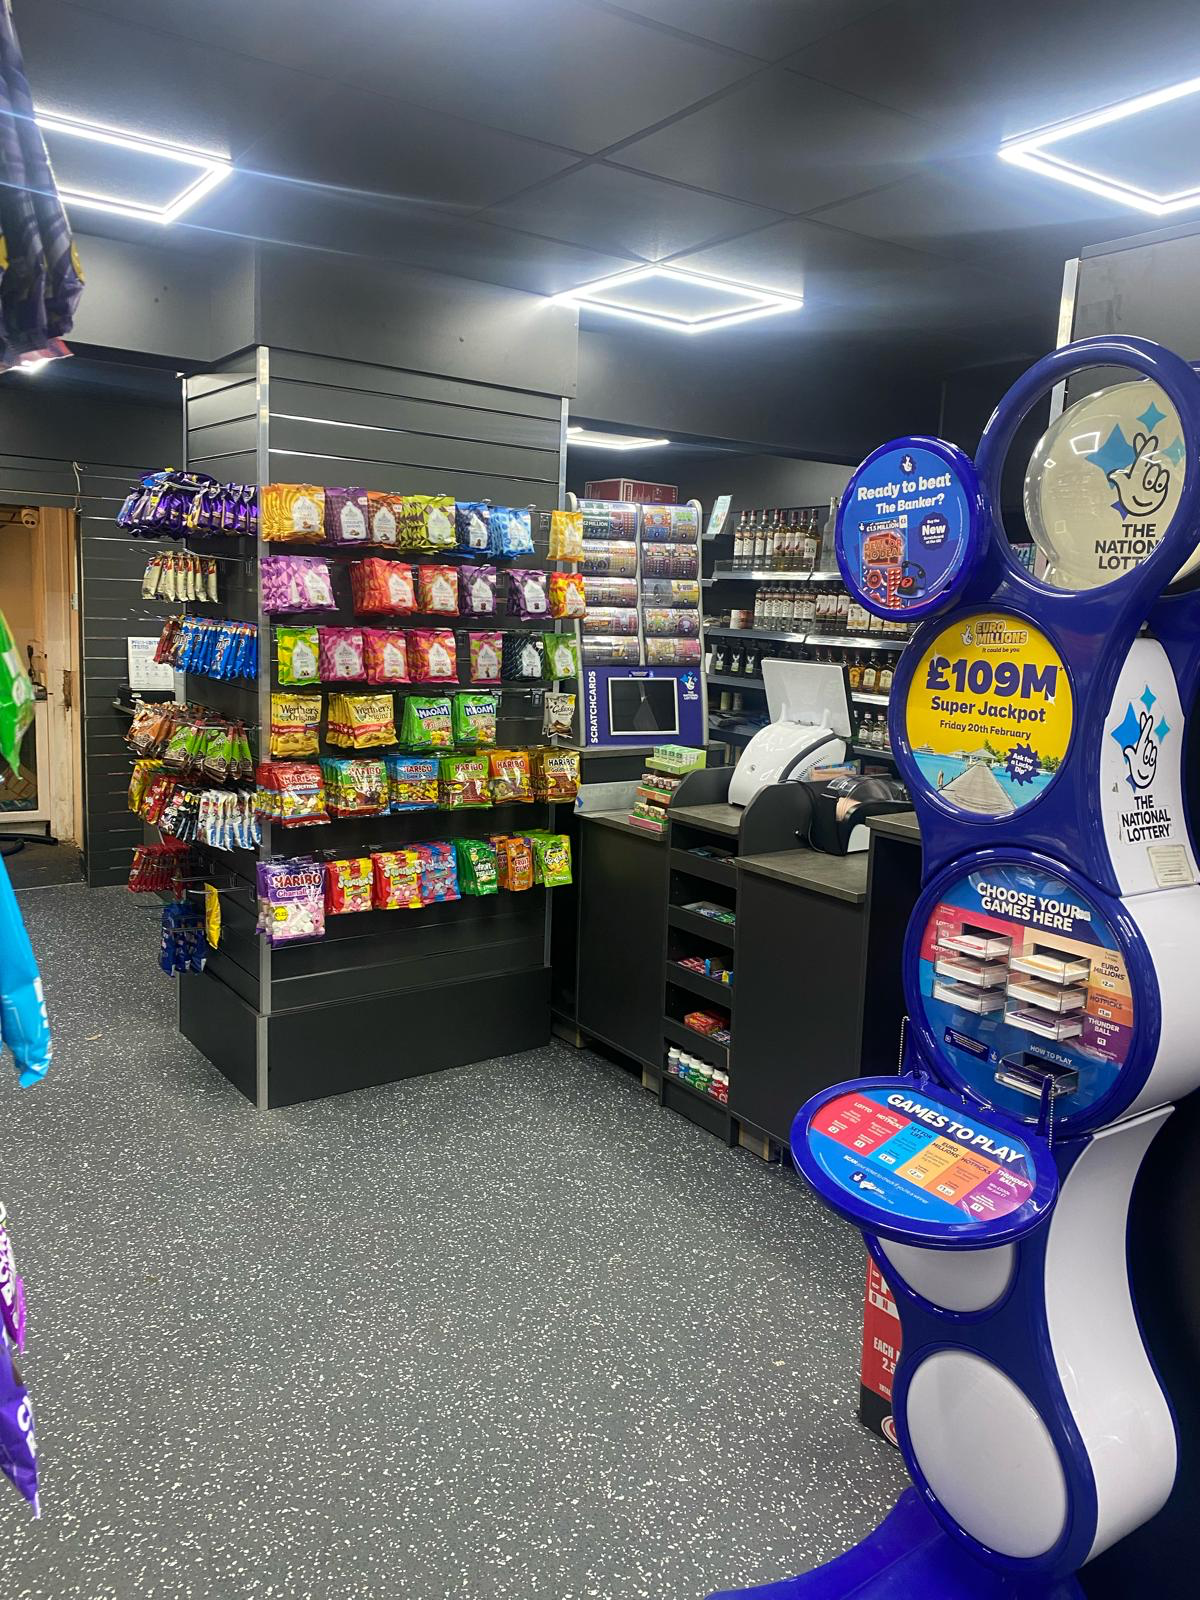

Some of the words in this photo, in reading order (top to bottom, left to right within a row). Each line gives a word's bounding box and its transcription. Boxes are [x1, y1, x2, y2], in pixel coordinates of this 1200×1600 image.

[857, 482, 900, 501] Ready
[902, 480, 916, 493] to
[918, 473, 951, 491] beat
[876, 502, 896, 514] The
[897, 493, 945, 511] Banker?
[922, 525, 946, 536] New
[1122, 523, 1156, 538] THE
[1095, 539, 1160, 554] NATION
[1098, 556, 1146, 569] LOTT
[976, 621, 1006, 633] EURO
[976, 631, 1027, 645] MILLIONS
[418, 705, 449, 718] MAOAM
[588, 671, 599, 743] SCRATCHCARDS
[931, 696, 976, 715] Super
[978, 701, 1046, 724] Jackpot
[940, 720, 966, 732] Friday
[968, 723, 988, 734] 20th
[990, 726, 1031, 740] February
[497, 760, 525, 769] HARIBO
[1134, 794, 1154, 810] THE
[1121, 809, 1171, 827] NATIONAL
[1127, 824, 1170, 842] LOTTERY
[274, 873, 321, 888] HARIBO
[976, 882, 1036, 908] CHOOSE
[1039, 897, 1081, 919] YOUR
[981, 897, 1031, 921] GAMES
[1033, 909, 1073, 932] HERE
[1093, 966, 1126, 980] MILLIONS
[1101, 963, 1120, 972] EURO
[1088, 1017, 1120, 1033] THUNDER
[1094, 1026, 1112, 1036] BALL
[1030, 1045, 1046, 1055] HOW
[1046, 1051, 1056, 1059] TO
[1056, 1053, 1073, 1065] PLAY
[853, 1102, 873, 1113] LOTTO
[887, 1094, 949, 1128] GAMES
[947, 1121, 974, 1140] TO
[971, 1134, 1024, 1163] PLAY
[932, 1142, 961, 1158] MILLIONS
[941, 1142, 959, 1152] EURO
[961, 1157, 991, 1174] HOTPICKS
[997, 1170, 1028, 1188] THUNDER
[873, 1336, 893, 1359] EACH
